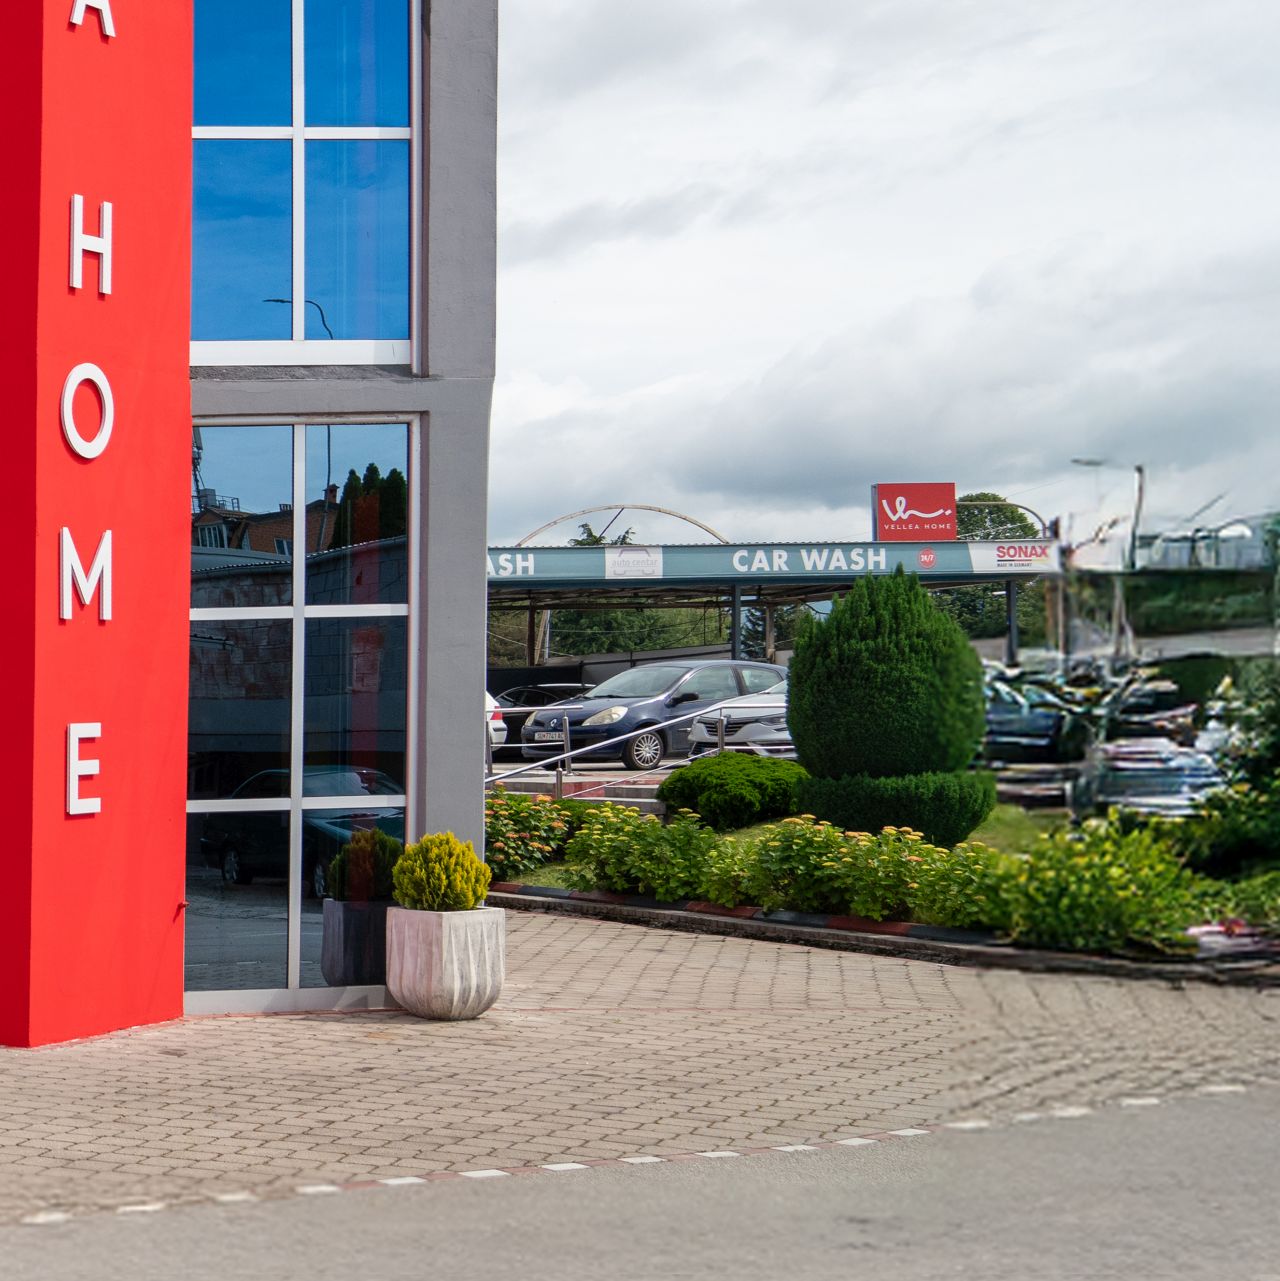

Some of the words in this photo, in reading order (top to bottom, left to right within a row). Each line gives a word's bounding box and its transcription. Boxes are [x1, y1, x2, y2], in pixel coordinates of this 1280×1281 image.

[60, 193, 114, 816] HOME
[732, 549, 789, 573] CAR
[800, 548, 886, 571] WASH
[996, 545, 1048, 558] SONAX
[610, 559, 630, 567] auto
